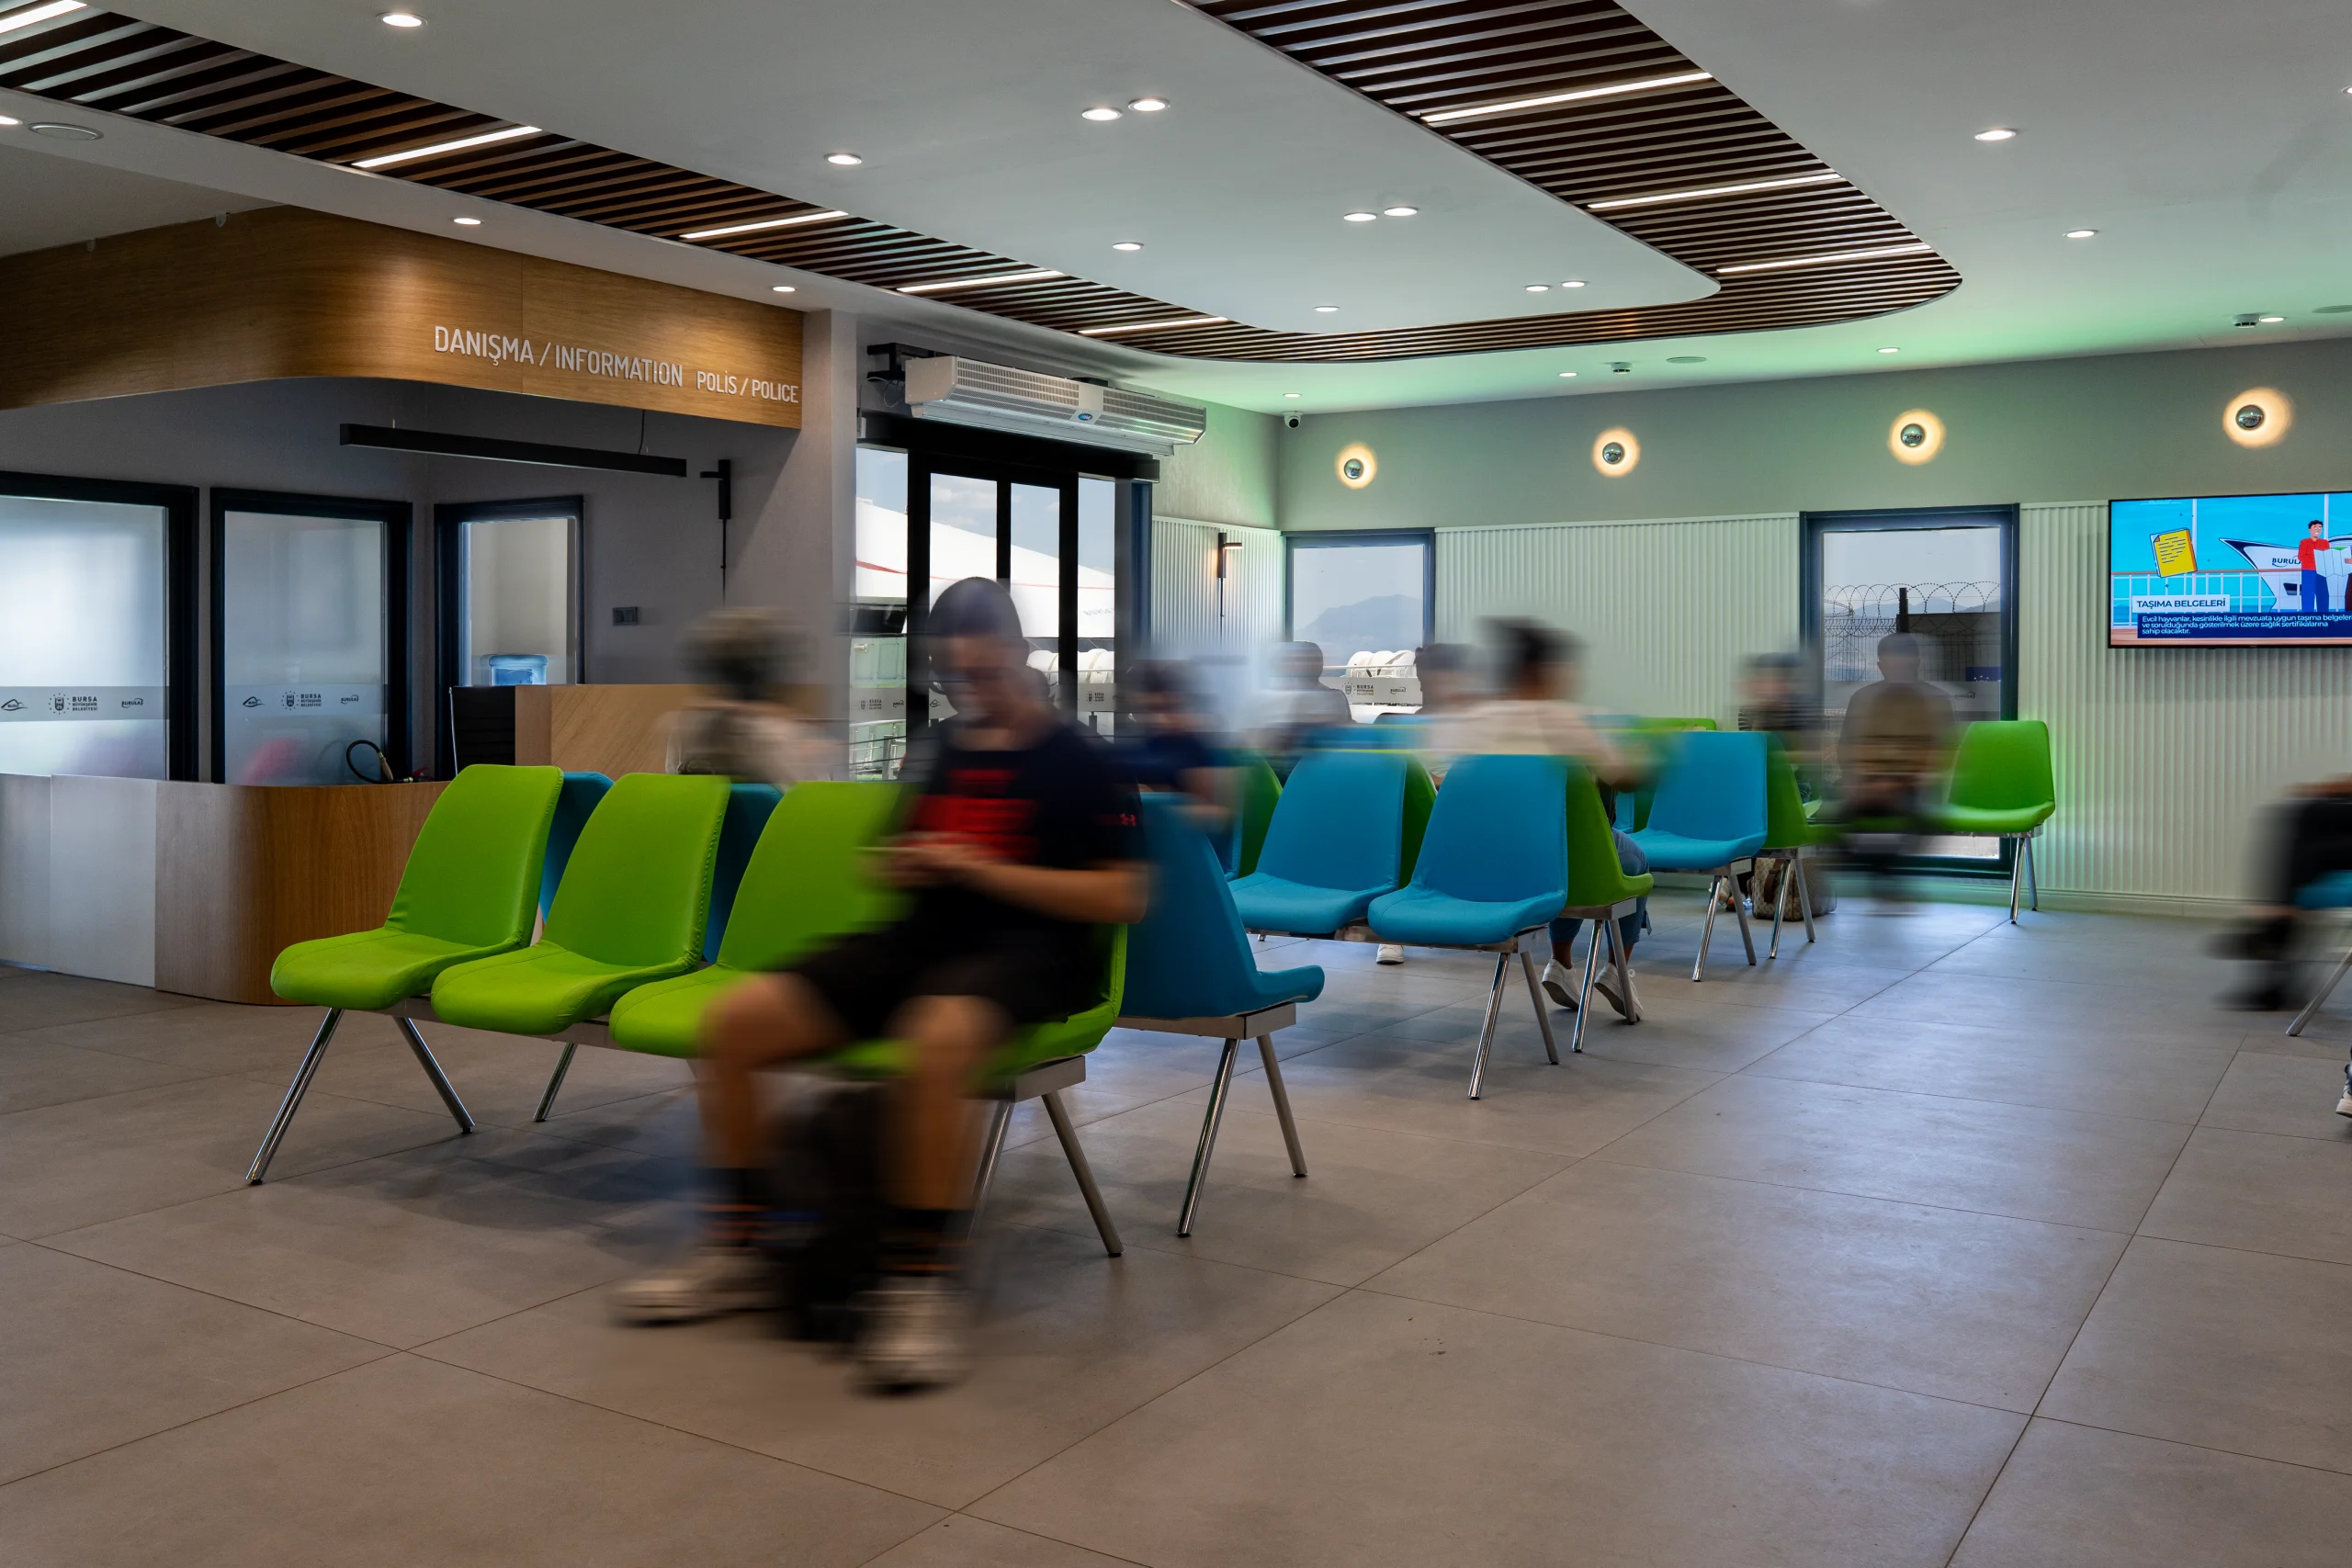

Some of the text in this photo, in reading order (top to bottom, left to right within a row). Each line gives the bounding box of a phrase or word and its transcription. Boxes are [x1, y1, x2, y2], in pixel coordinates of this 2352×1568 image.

[435, 326, 683, 388] DANIŞMA / INFORMATION
[696, 370, 798, 403] POLİS / POLICE
[2137, 598, 2226, 609] TAŞIMA BELGELERİ
